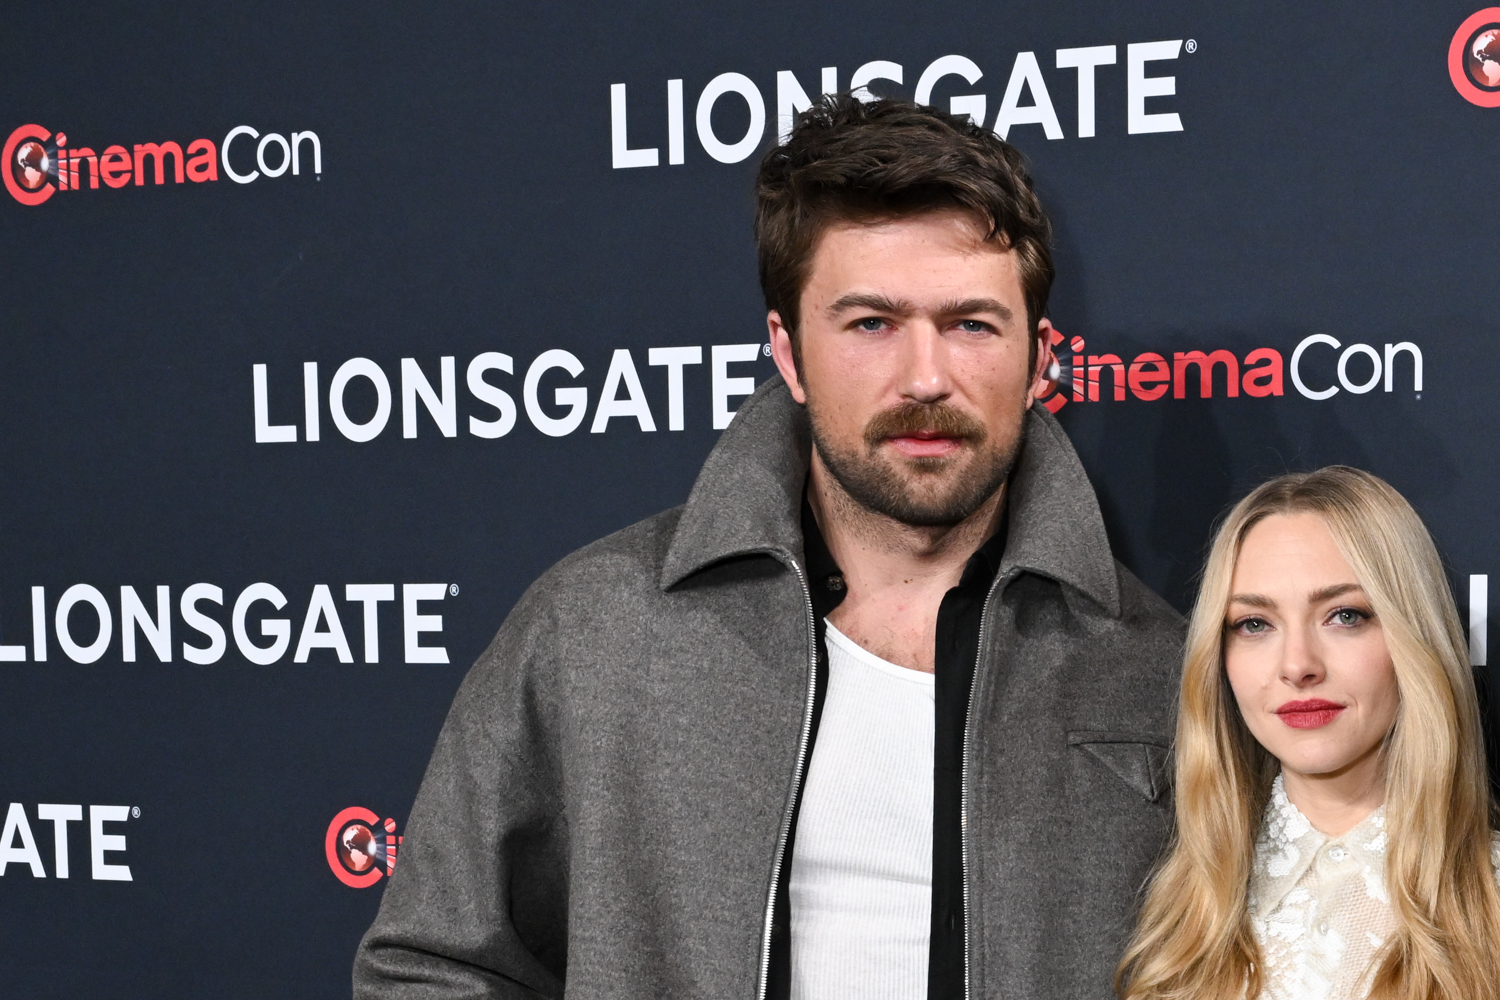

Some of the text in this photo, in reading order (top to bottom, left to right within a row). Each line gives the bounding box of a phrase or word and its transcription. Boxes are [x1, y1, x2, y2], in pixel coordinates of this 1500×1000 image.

[1, 123, 322, 206] CinemaCon
[253, 343, 761, 443] LIONSGATE
[1041, 326, 1422, 415] inemaCon
